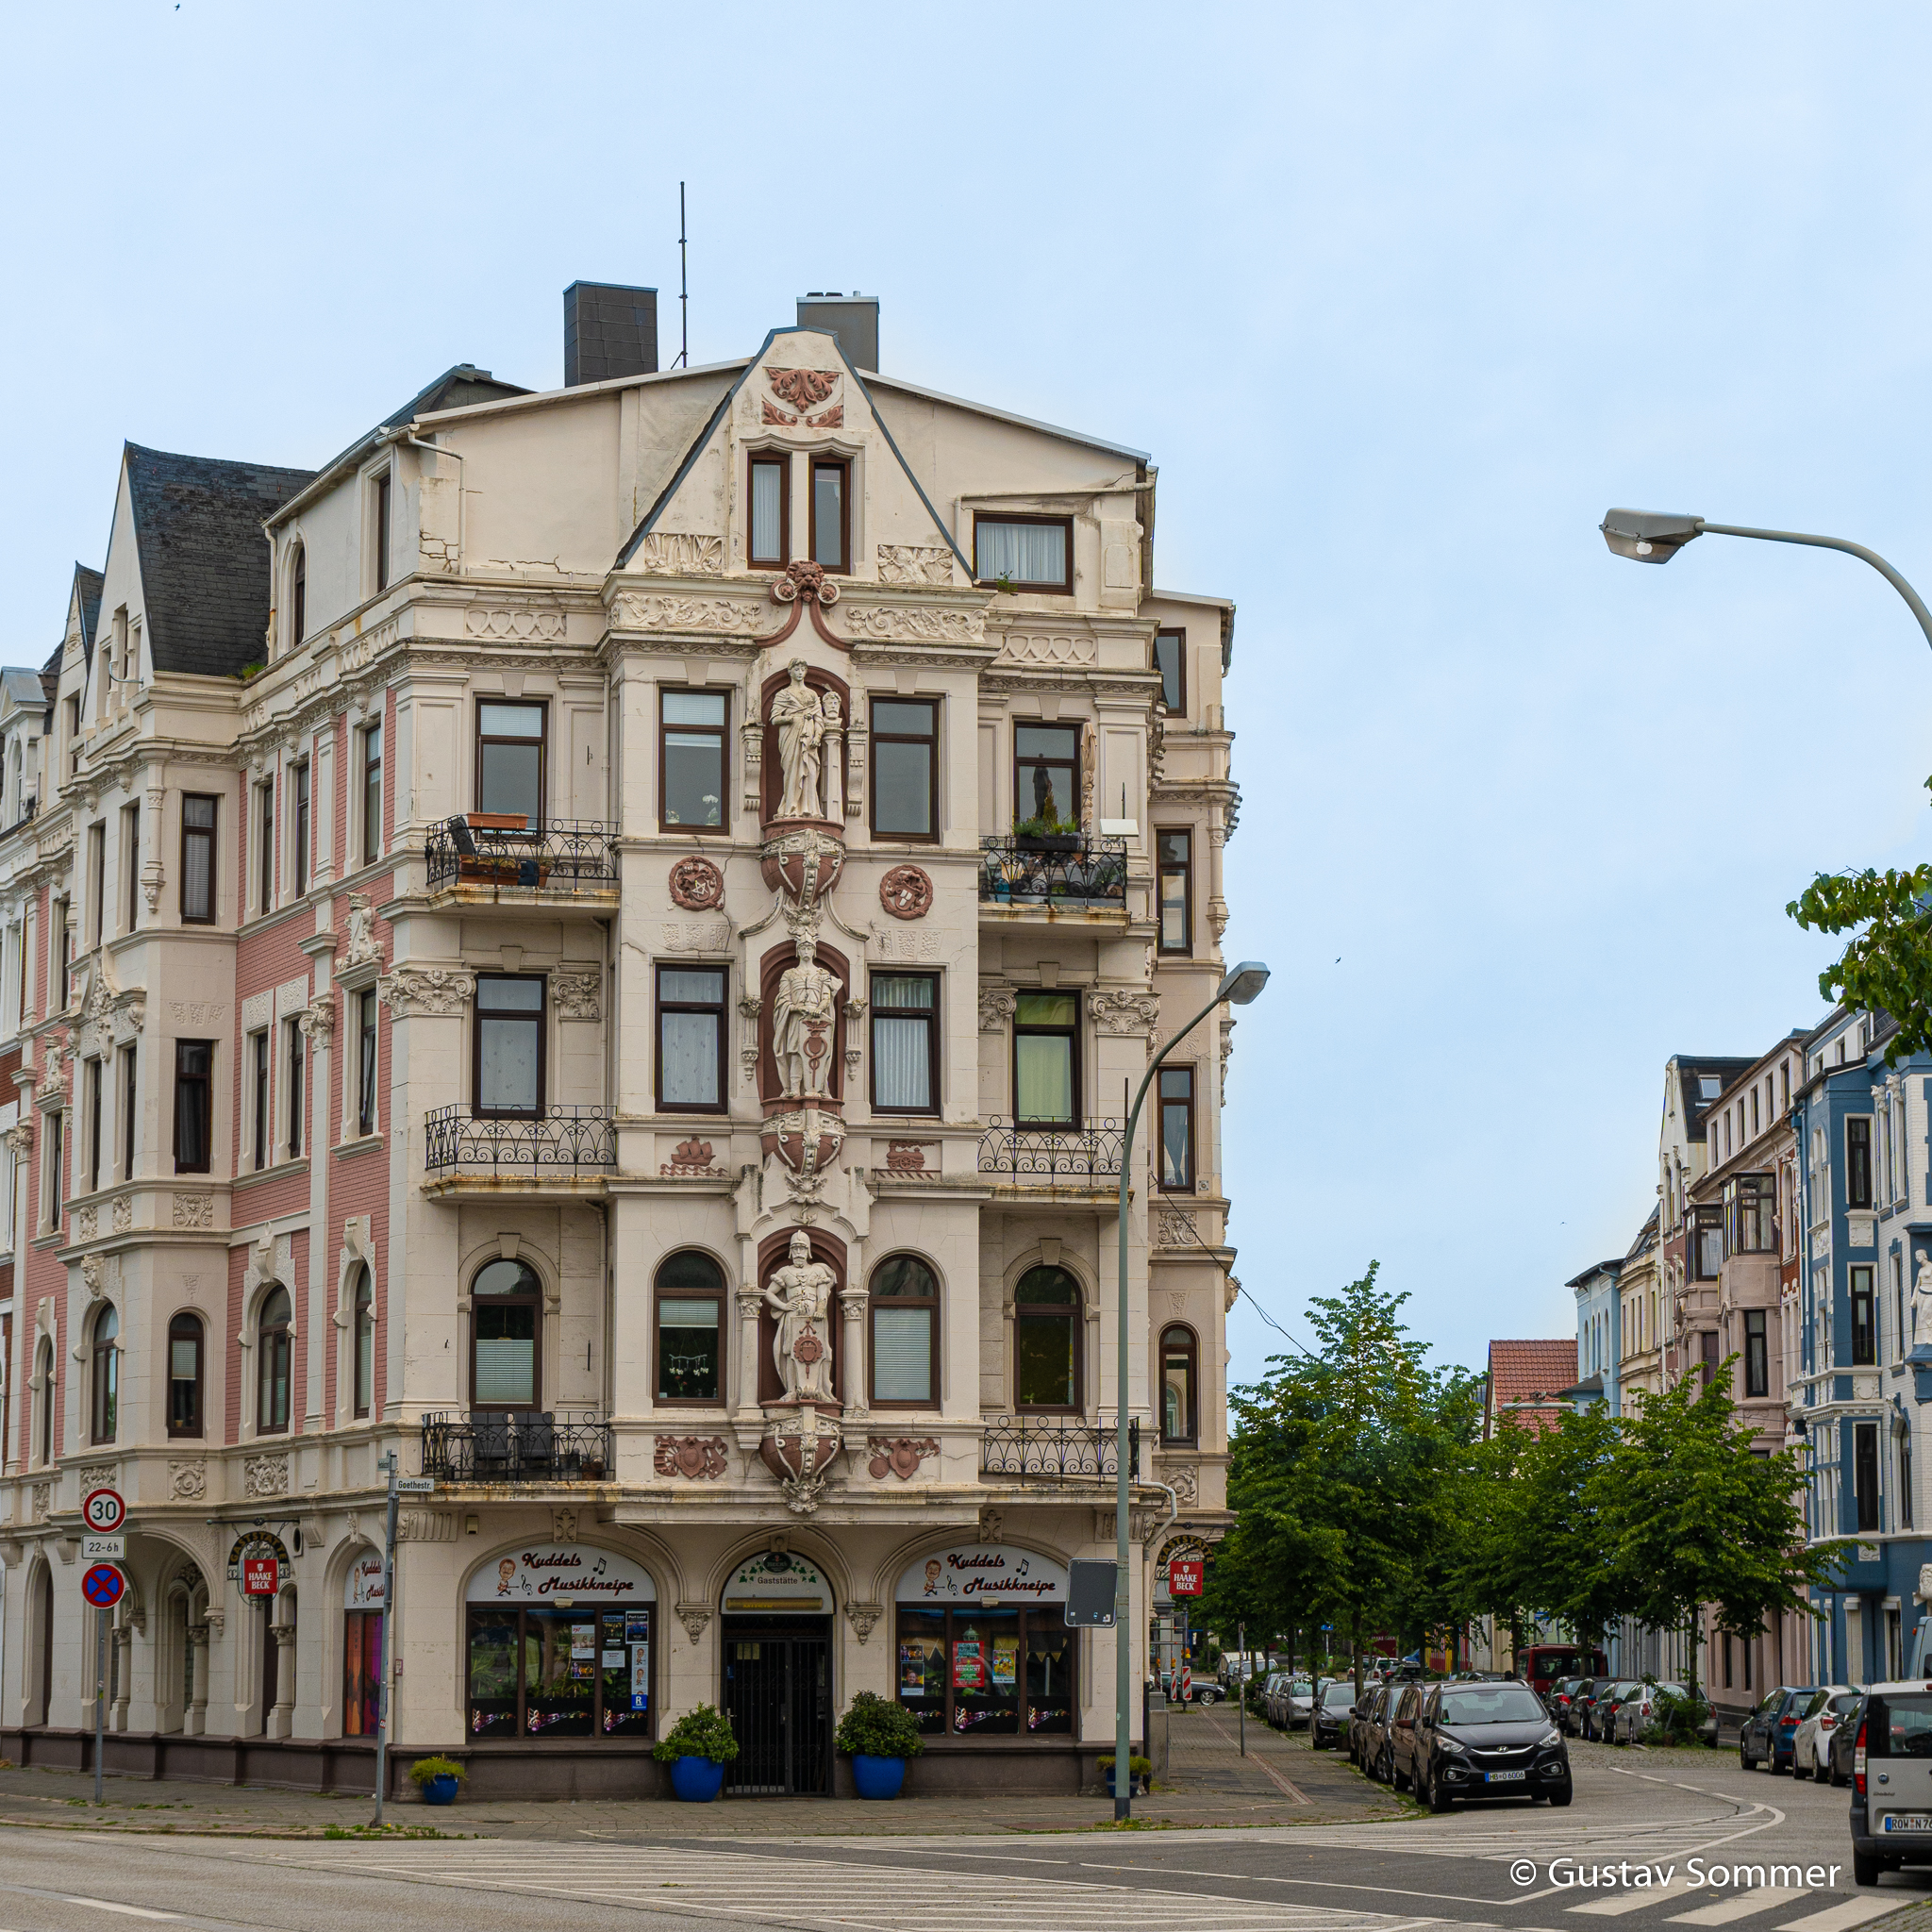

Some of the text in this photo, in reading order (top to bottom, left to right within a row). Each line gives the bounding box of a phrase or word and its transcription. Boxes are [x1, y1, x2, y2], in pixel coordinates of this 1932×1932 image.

[398, 1480, 432, 1490] Goethestr.
[92, 1501, 117, 1521] 30
[522, 1553, 582, 1569] Kuddels
[946, 1554, 1006, 1570] Kuddels
[248, 1572, 273, 1581] HAAKE
[757, 1576, 798, 1585] Gaststätte
[1174, 1574, 1198, 1583] HAAKE
[251, 1580, 271, 1590] BECK
[537, 1576, 635, 1597] Musikkneipe
[962, 1576, 1057, 1597] Musikkneipe
[1175, 1582, 1195, 1591] BECK
[1891, 1819, 1909, 1829] ROW
[1915, 1819, 1922, 1829] N
